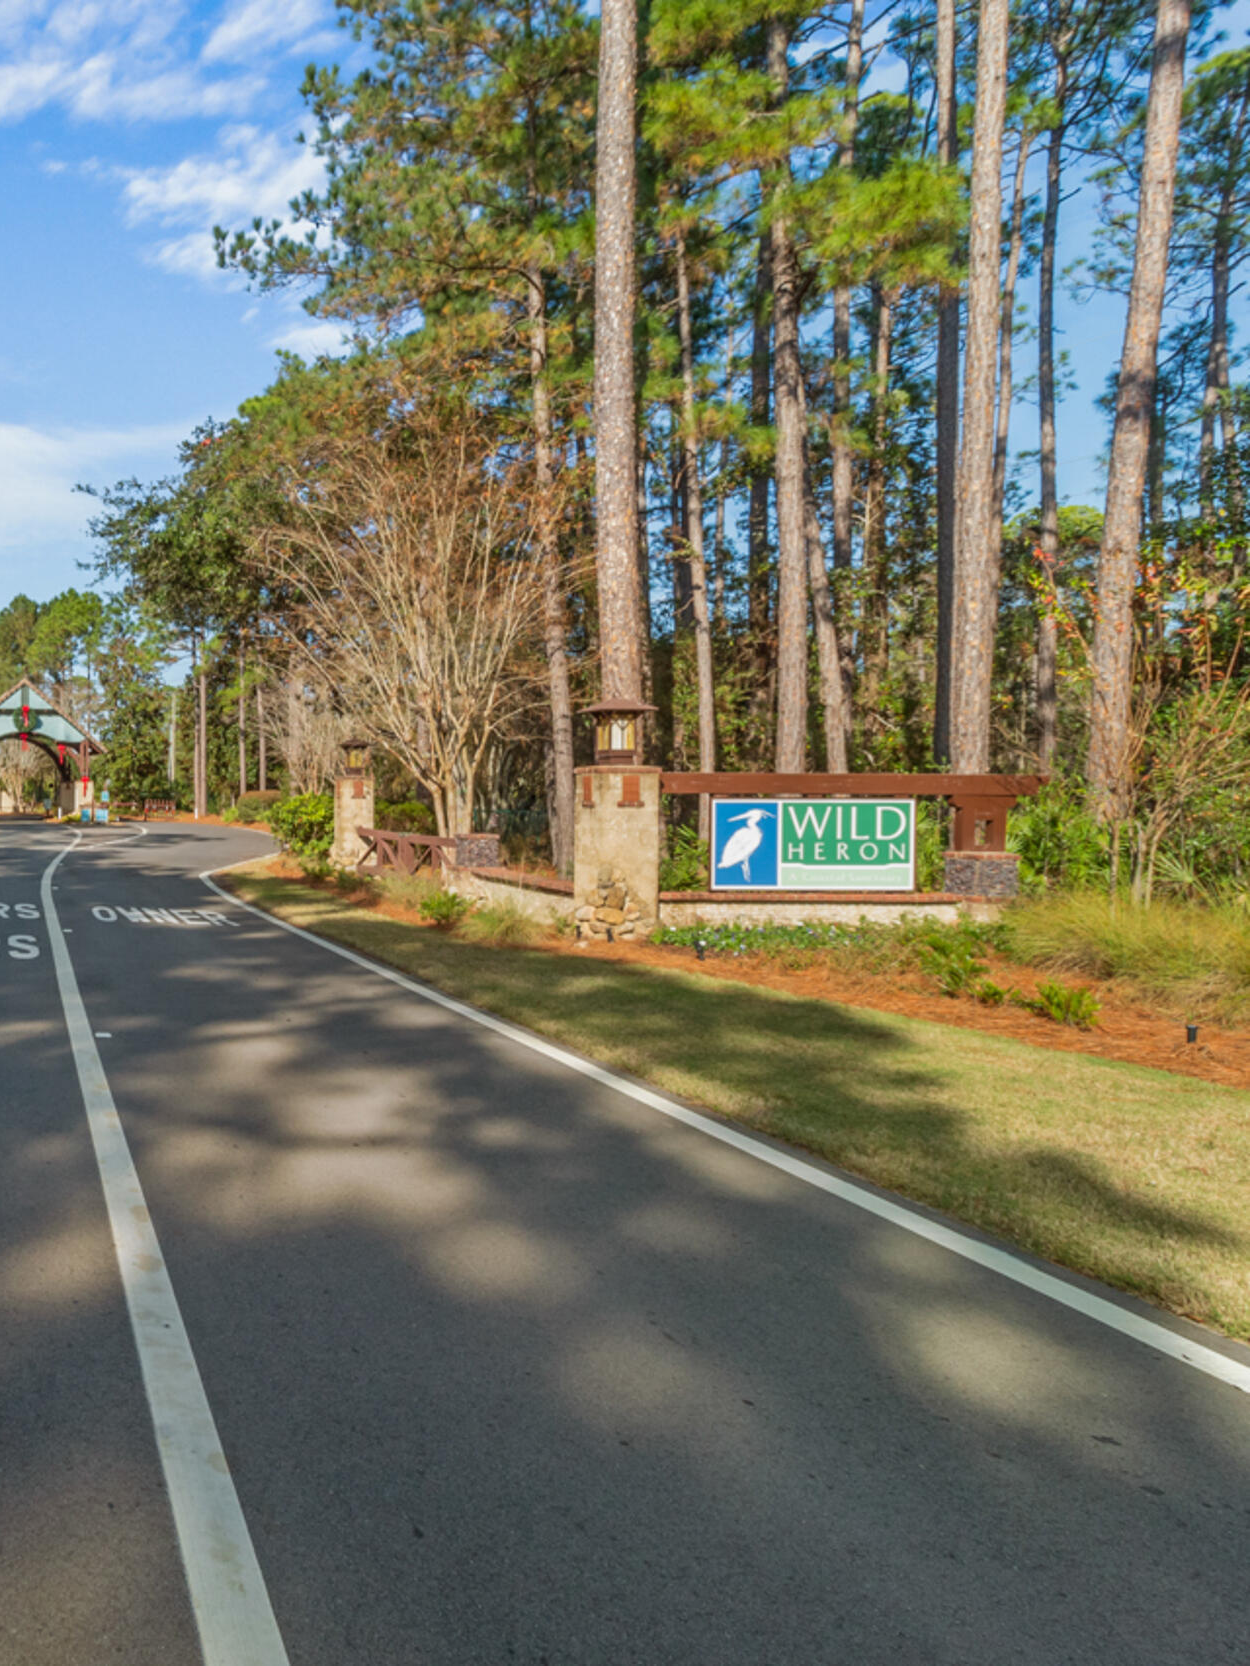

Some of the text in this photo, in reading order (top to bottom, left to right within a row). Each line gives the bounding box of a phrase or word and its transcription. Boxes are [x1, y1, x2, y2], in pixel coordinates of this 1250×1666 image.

[787, 806, 907, 841] WILD
[788, 842, 906, 861] HERON
[91, 905, 240, 927] OWNER
